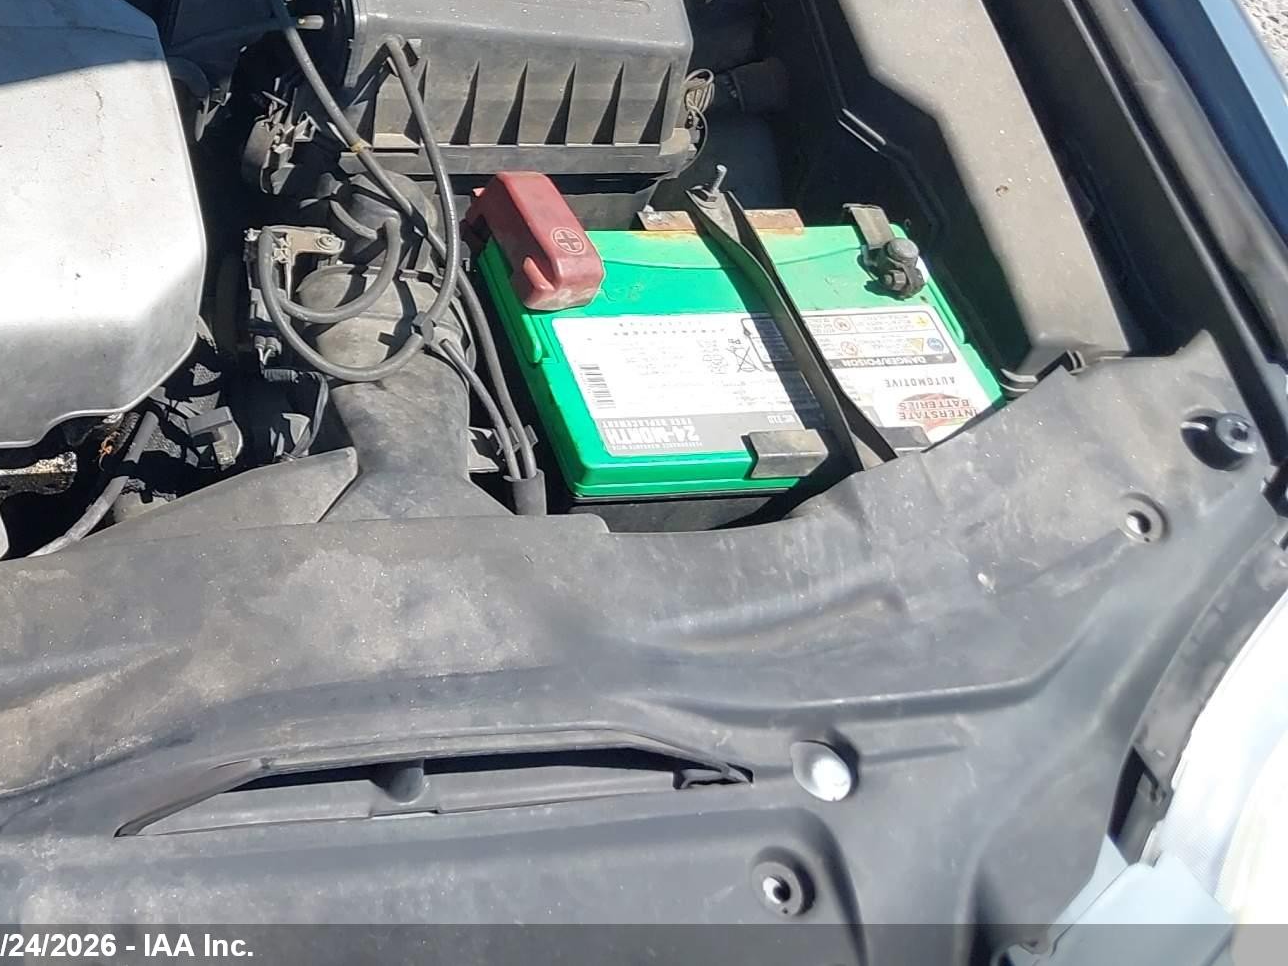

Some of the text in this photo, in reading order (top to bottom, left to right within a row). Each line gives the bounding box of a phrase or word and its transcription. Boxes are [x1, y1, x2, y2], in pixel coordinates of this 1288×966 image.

[884, 376, 956, 388] AUTOMOTIVE
[898, 398, 970, 410] BATTERIES
[898, 406, 977, 420] INTERSTATE
[602, 424, 700, 444] 24-MONTH
